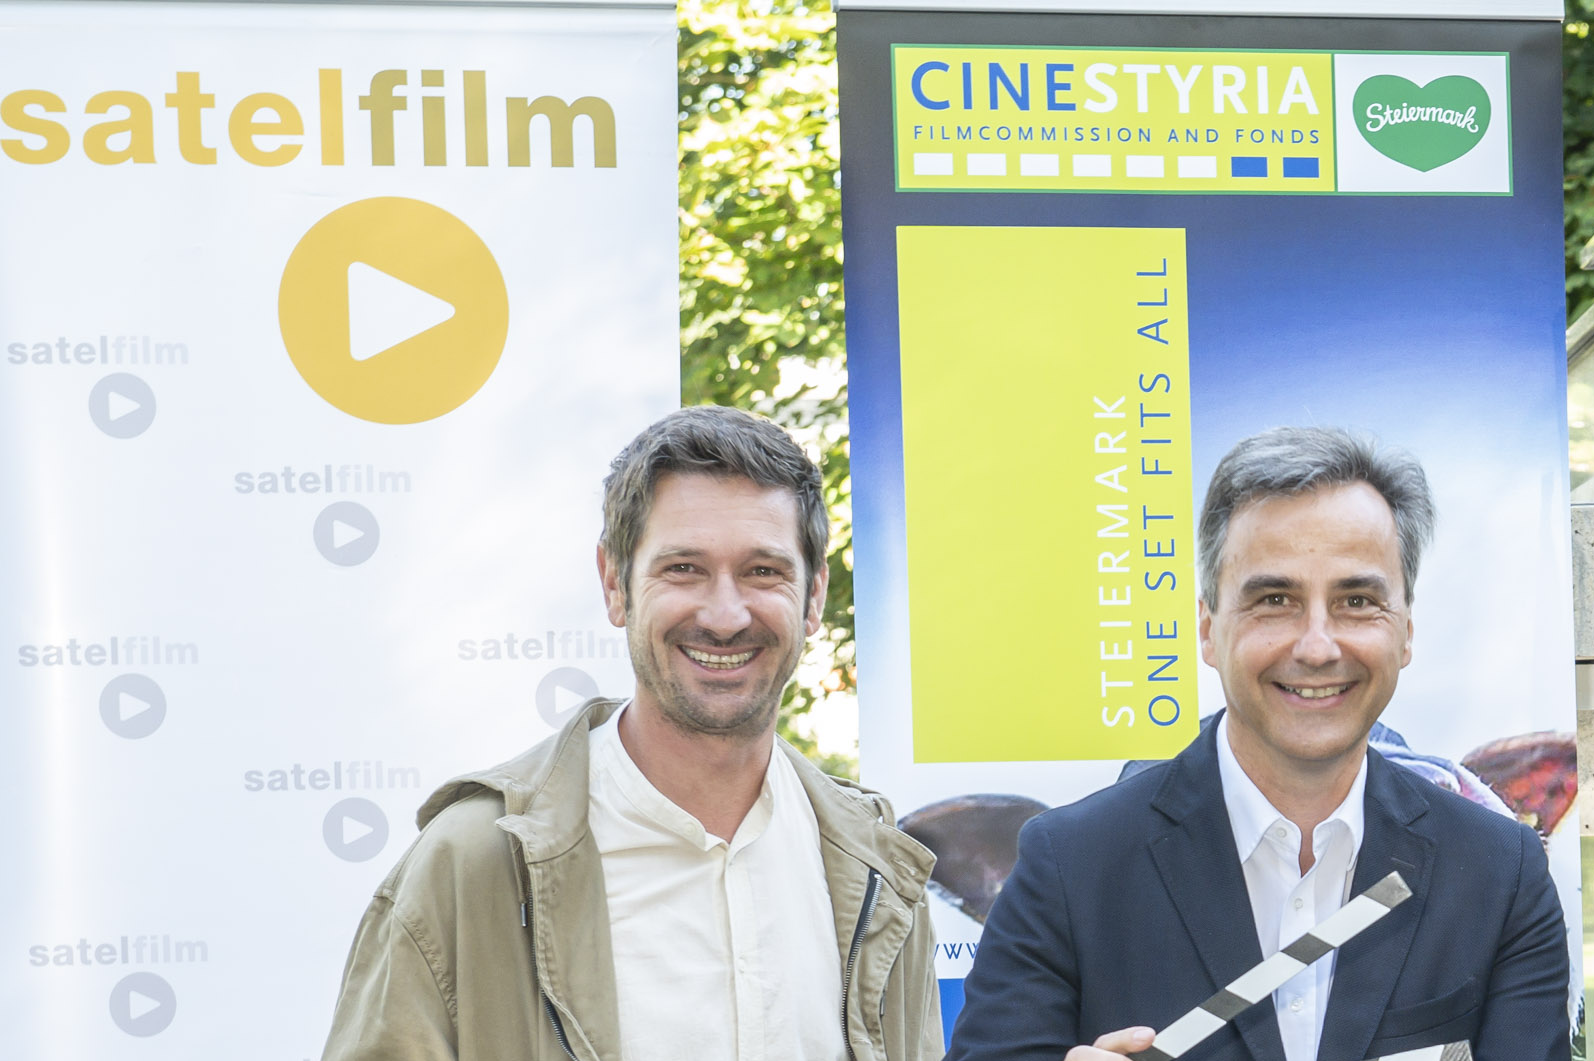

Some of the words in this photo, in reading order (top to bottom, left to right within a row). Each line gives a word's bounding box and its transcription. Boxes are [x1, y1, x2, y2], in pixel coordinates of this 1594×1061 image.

[910, 60, 1320, 116] CINESTYRIA
[0, 67, 618, 169] satelfilm
[913, 124, 1152, 143] FILMCOMMISSION
[1167, 127, 1220, 144] AND
[1235, 128, 1320, 145] FONDS
[1365, 101, 1480, 136] Steiermark
[1135, 257, 1170, 346] ALL
[6, 335, 189, 367] satelfilm
[1138, 372, 1173, 476] FITS
[233, 464, 413, 496] satelfilm
[1092, 394, 1136, 728] STEIERMARK
[1142, 504, 1178, 591] SET
[17, 636, 200, 668] satelfilm
[1145, 620, 1181, 727] ONE
[243, 761, 422, 793] satelfilm
[28, 934, 210, 968] satelfilm
